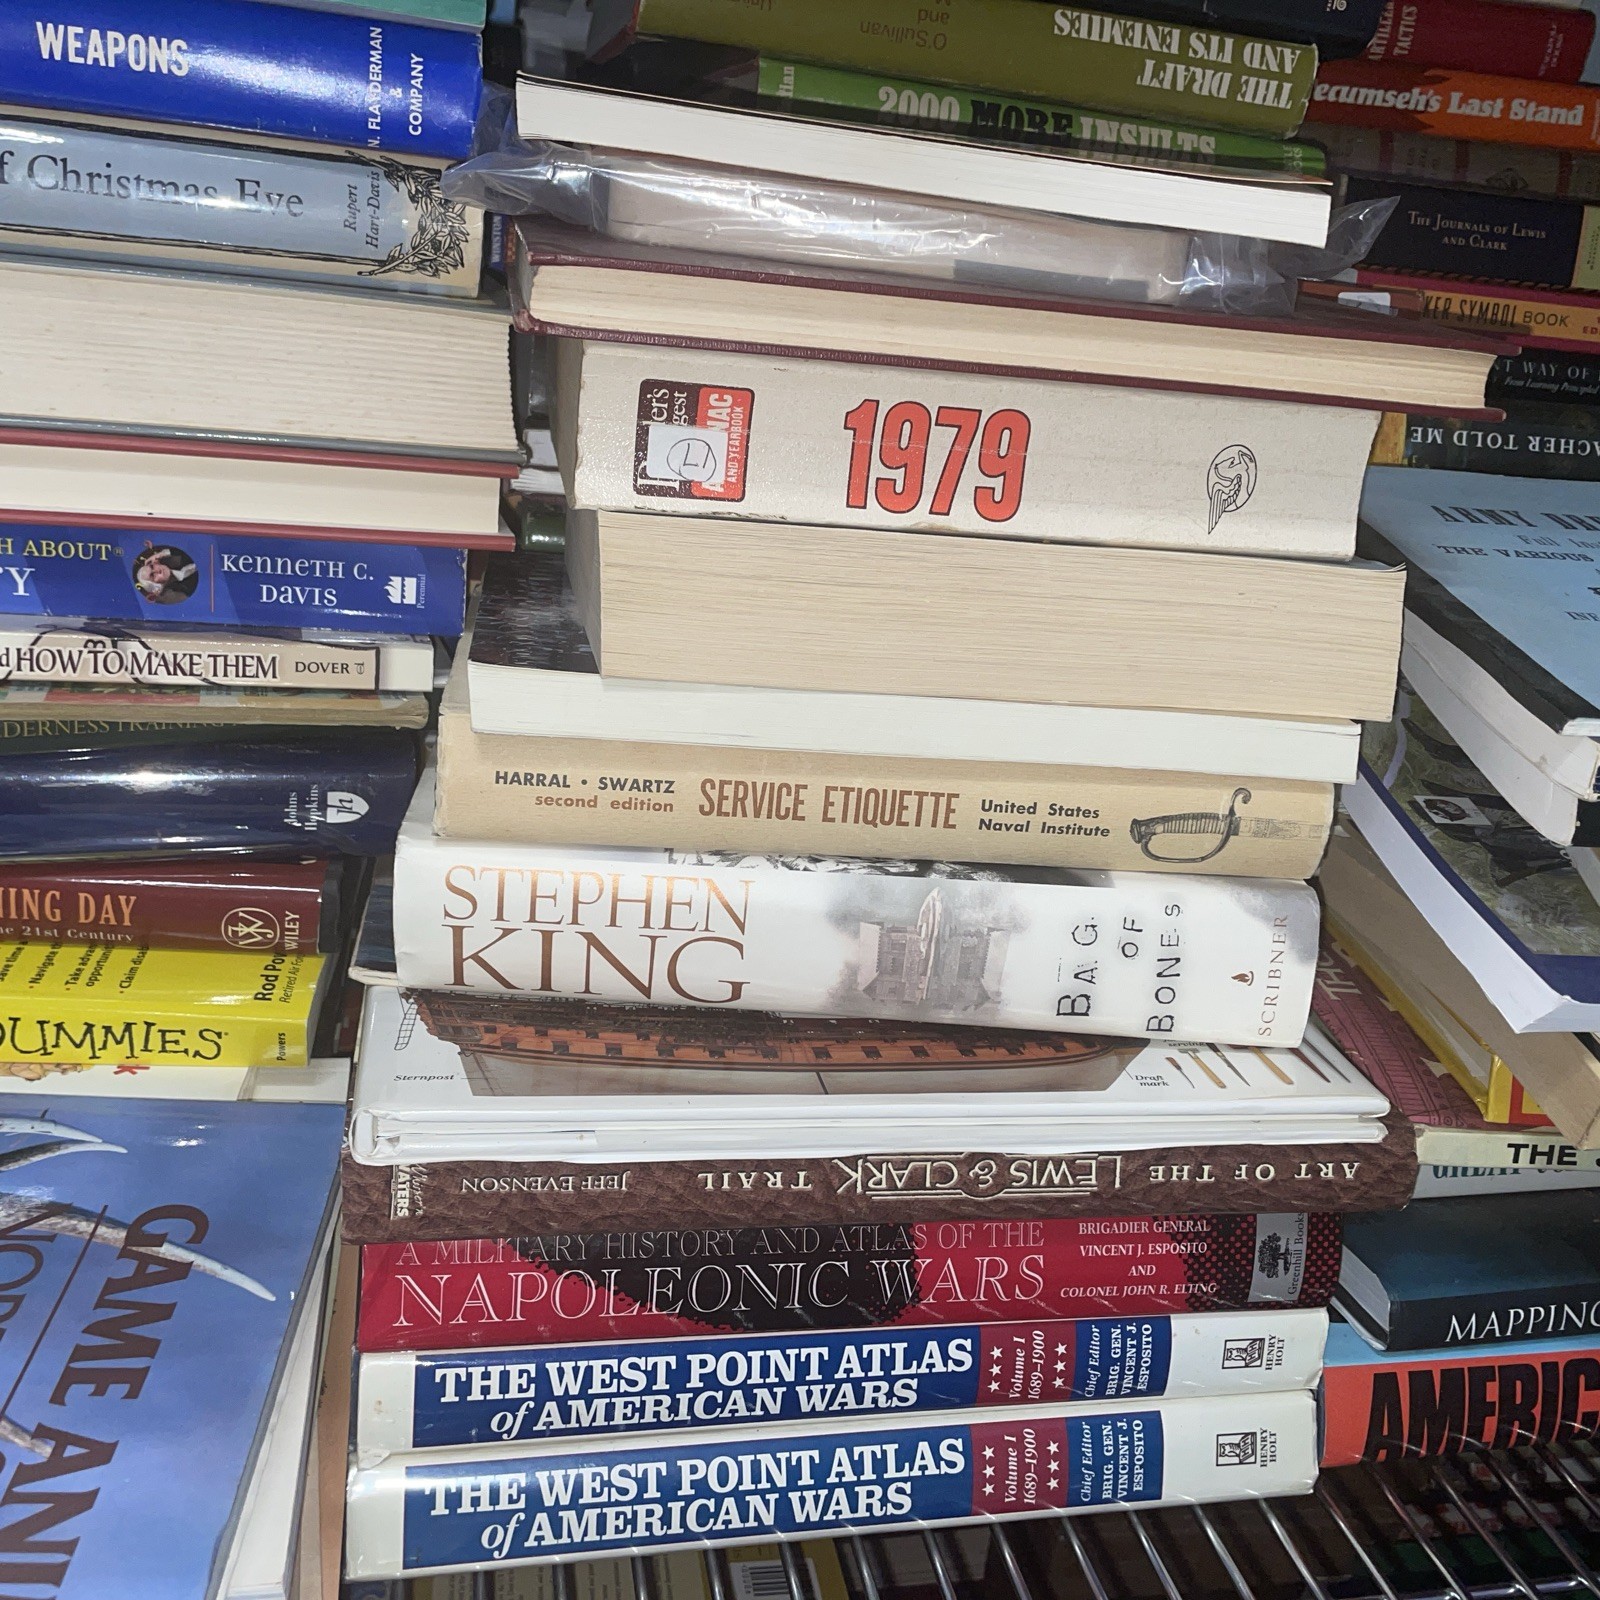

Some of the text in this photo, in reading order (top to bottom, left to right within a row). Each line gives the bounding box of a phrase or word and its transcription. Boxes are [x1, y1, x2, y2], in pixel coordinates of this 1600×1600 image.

[36, 21, 189, 77] WEAPONS
[859, 20, 948, 50] O'Sullivan
[1053, 8, 1301, 75] AND ITS ENEMIES
[409, 53, 424, 136] COMPANY
[1136, 59, 1293, 109] THE DRAFT
[878, 86, 960, 124] 2000
[970, 100, 1074, 138] MORE
[1447, 92, 1505, 119] Last
[1509, 98, 1585, 127] Stand
[27, 154, 305, 218] Christmas Eve
[344, 184, 358, 232] Rupert
[366, 170, 381, 249] Hart-Davis
[1522, 310, 1571, 328] BOOK
[727, 406, 745, 483] AND YEARBOOK
[1410, 426, 1519, 451] TOLD ME
[844, 398, 1032, 524] 1979
[1430, 505, 1539, 529] ARMY
[1436, 545, 1595, 563] THE VARIOUS
[1517, 534, 1561, 548] Full
[353, 561, 375, 582] C.
[416, 573, 426, 610] Perennial
[16, 648, 279, 681] HOW TO MAKE THEM
[295, 661, 351, 675] DOVER
[494, 770, 676, 795] HARRAL SWARTZ
[534, 795, 675, 813] second edition
[698, 777, 961, 830] SERVICE ETIQUETTE
[980, 799, 1101, 819] United States
[978, 817, 1111, 838] Naval Institute
[78, 892, 138, 928] DAY
[443, 864, 756, 936] STEPHEN
[21, 925, 134, 943] 21st Century
[284, 910, 301, 951] WILEY
[1120, 915, 1145, 959] OF
[28, 951, 60, 985] Navigate
[64, 966, 85, 986] Take
[118, 966, 140, 989] Claim
[441, 923, 751, 1004] KING
[1145, 902, 1183, 1034] BONES
[1258, 914, 1289, 1037] SCRIBNER
[253, 974, 280, 1001] Rod
[279, 975, 298, 1004] Retired
[276, 1032, 287, 1062] Powers
[394, 1073, 456, 1083] Sternpost
[1134, 1074, 1166, 1084] Draft
[1139, 1080, 1170, 1088] mark
[1507, 1143, 1578, 1166] THE
[461, 1170, 632, 1193] JEFF EVENSON
[697, 1155, 1363, 1196] ART OF THE LEWIS & CLARK TRAIL
[396, 1220, 1046, 1267] A MILITARY HISTORY AND ATLAS OF THE
[1078, 1218, 1212, 1235] BRIGADIER GENERAL
[1079, 1241, 1209, 1257] VINCENT J. ESPOSITO
[392, 1253, 1046, 1328] NAPOLEONIC WARS
[1060, 1281, 1219, 1298] COLONEL JOHN R. ELTING
[1127, 1263, 1157, 1277] AND
[1287, 1247, 1305, 1295] Greenhill
[48, 1203, 211, 1408] GAME
[435, 1338, 974, 1403] THE WEST POINT ATLAS
[1009, 1335, 1027, 1400] Volume I
[1083, 1324, 1101, 1398] Chief Editor
[1105, 1323, 1123, 1397] BRIG. GEN.
[1120, 1321, 1138, 1397] VINCENT J.
[1136, 1323, 1153, 1392] ESPOSITO
[1264, 1333, 1277, 1371] HENRY
[1274, 1337, 1285, 1366] HOLT
[490, 1377, 919, 1440] of AMERICAN WARS
[1080, 1420, 1096, 1502] Chief Editor
[1101, 1420, 1114, 1500] BRIG. GEN.
[1117, 1417, 1130, 1500] VINCENT J.
[1131, 1419, 1144, 1492] ESPOSITO
[1259, 1427, 1269, 1468] HENRY
[1268, 1430, 1278, 1463] HOLT
[424, 1437, 966, 1517] THE WEST POINT ATLAS
[1004, 1434, 1018, 1504] Volume I
[480, 1481, 913, 1560] of AMERICAN WARS
